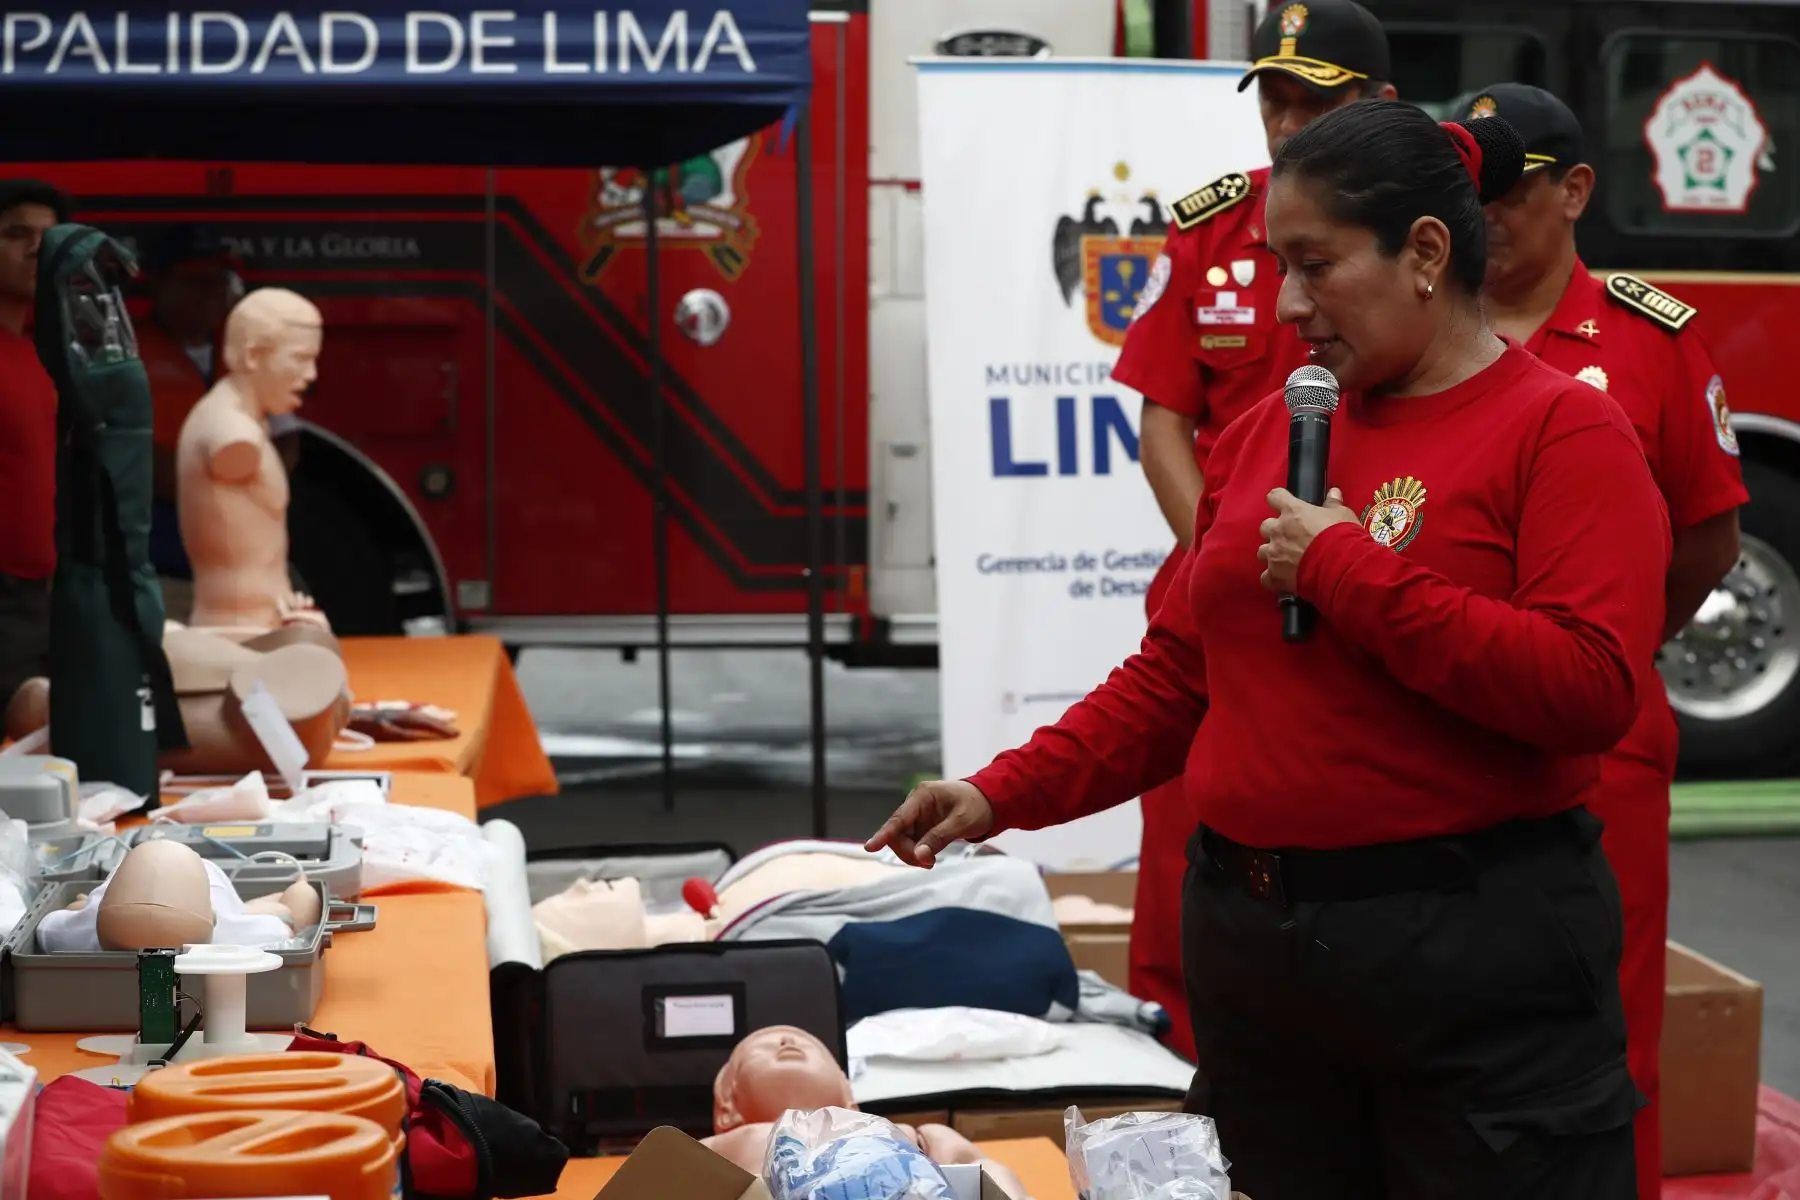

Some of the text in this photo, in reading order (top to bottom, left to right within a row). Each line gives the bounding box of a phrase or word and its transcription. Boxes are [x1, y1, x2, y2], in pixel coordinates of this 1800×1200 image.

[1, 9, 758, 76] PALIDAD DE LIMA
[261, 236, 279, 258] Y
[284, 236, 314, 258] LA
[985, 362, 1112, 387] MUNICIP
[977, 552, 1067, 575] Gerencia
[1072, 552, 1098, 572] de
[1068, 579, 1094, 599] de
